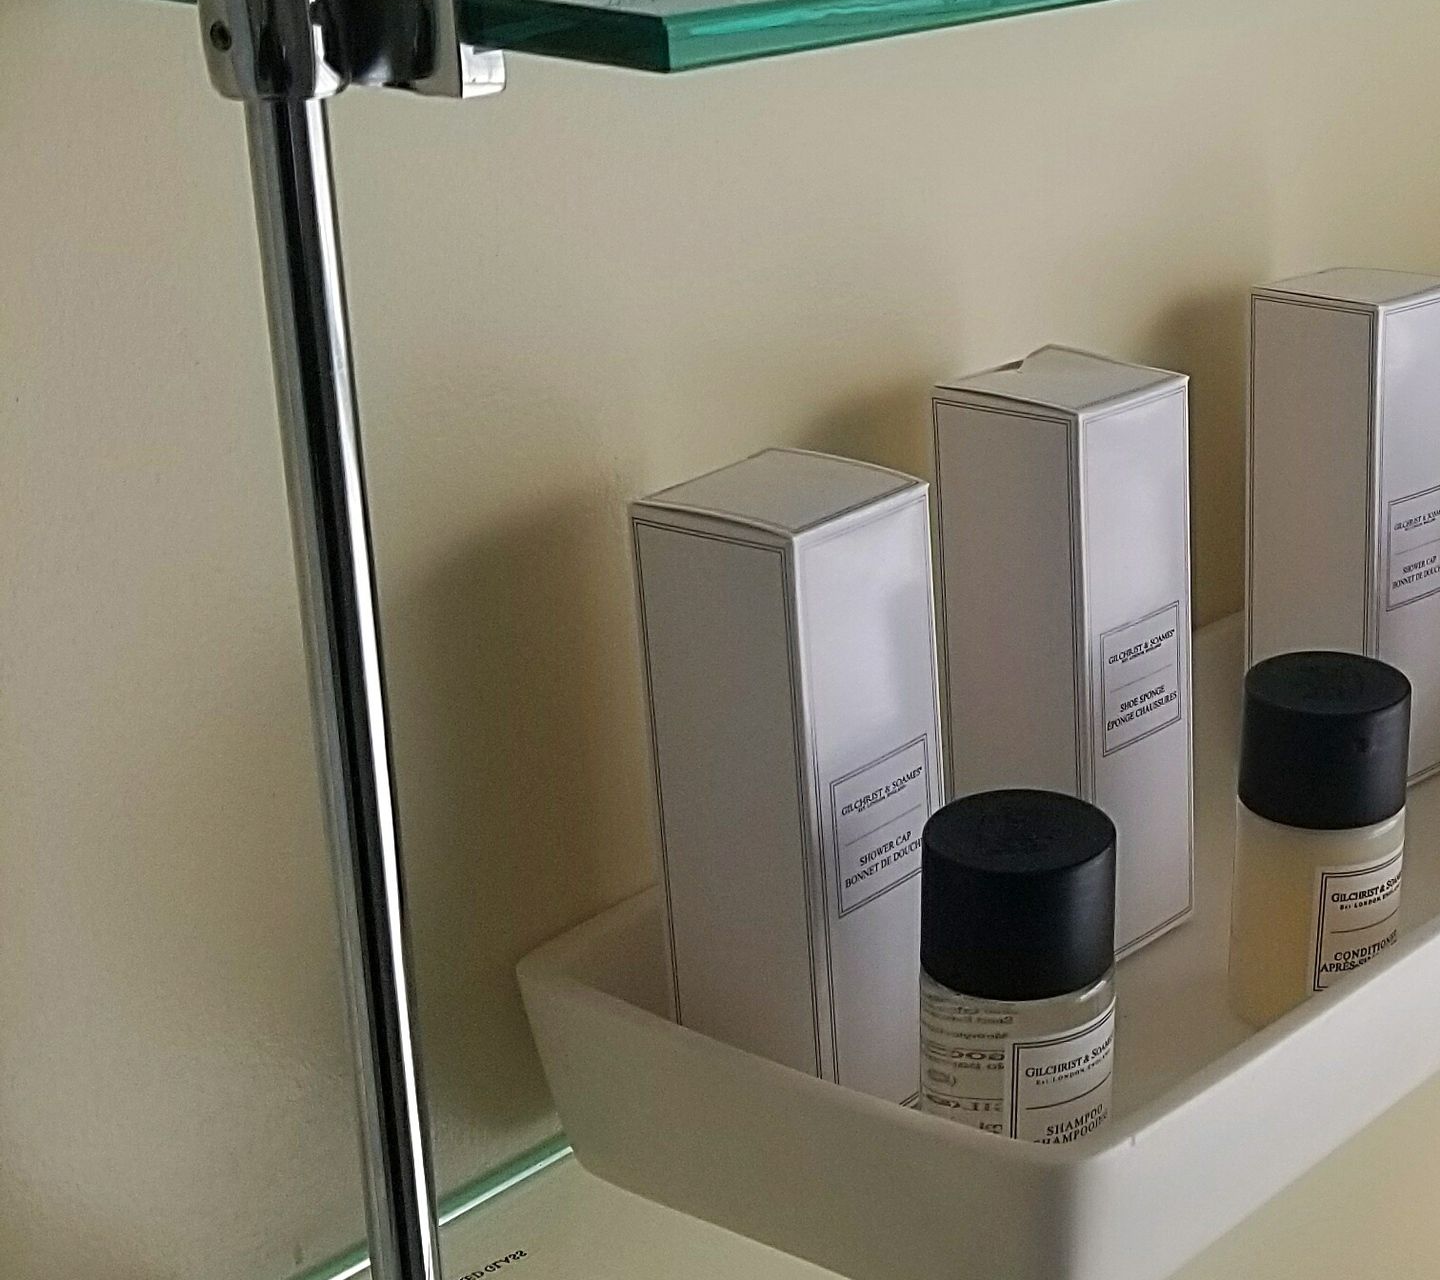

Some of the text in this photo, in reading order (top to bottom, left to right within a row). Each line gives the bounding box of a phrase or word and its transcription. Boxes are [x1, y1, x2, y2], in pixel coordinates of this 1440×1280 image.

[841, 788, 883, 816] GILCHRIST
[885, 784, 891, 794] &
[845, 838, 923, 888] BONNET DE DOUCH
[859, 831, 912, 867] SHOWER CAP
[1331, 886, 1380, 903] GILCHRIST
[1379, 883, 1385, 894] &
[1025, 1057, 1083, 1078] GILCHRIST
[1083, 1054, 1090, 1064] &
[1046, 1103, 1103, 1136] SHAMPOO
